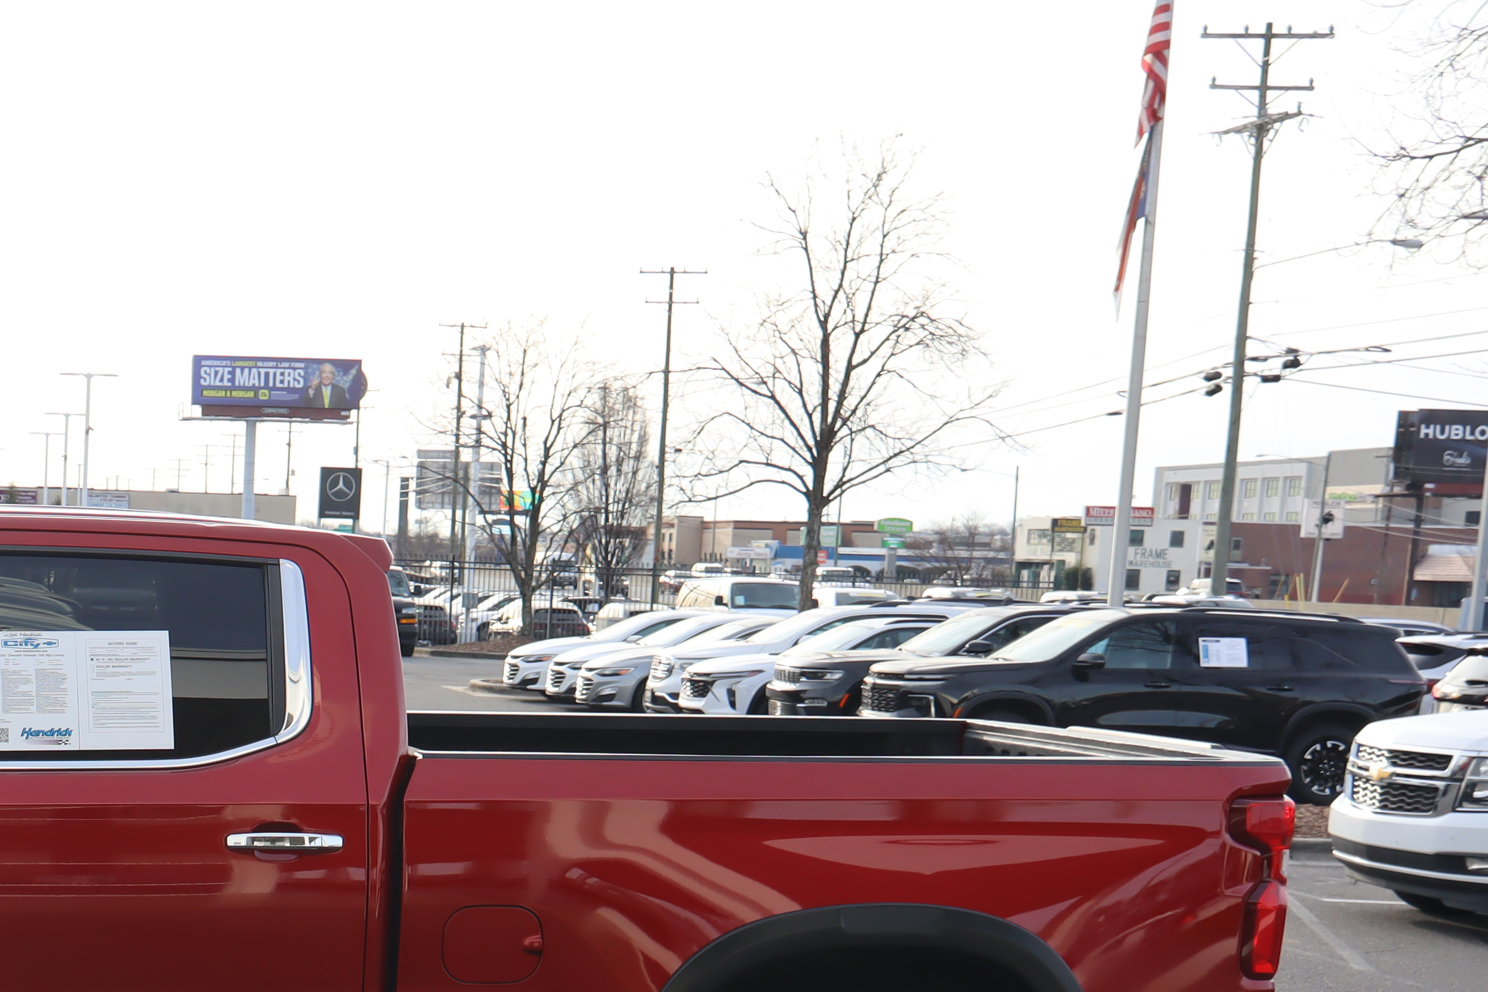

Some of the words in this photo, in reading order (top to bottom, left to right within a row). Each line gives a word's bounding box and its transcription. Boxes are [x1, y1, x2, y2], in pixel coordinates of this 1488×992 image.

[200, 366, 232, 386] SIZE
[235, 368, 305, 388] MATTERS
[1419, 424, 1488, 440] HUBLO
[1134, 548, 1169, 560] FRAME
[1127, 560, 1173, 568] WAREHOUSE
[21, 727, 74, 740] Hendrick
